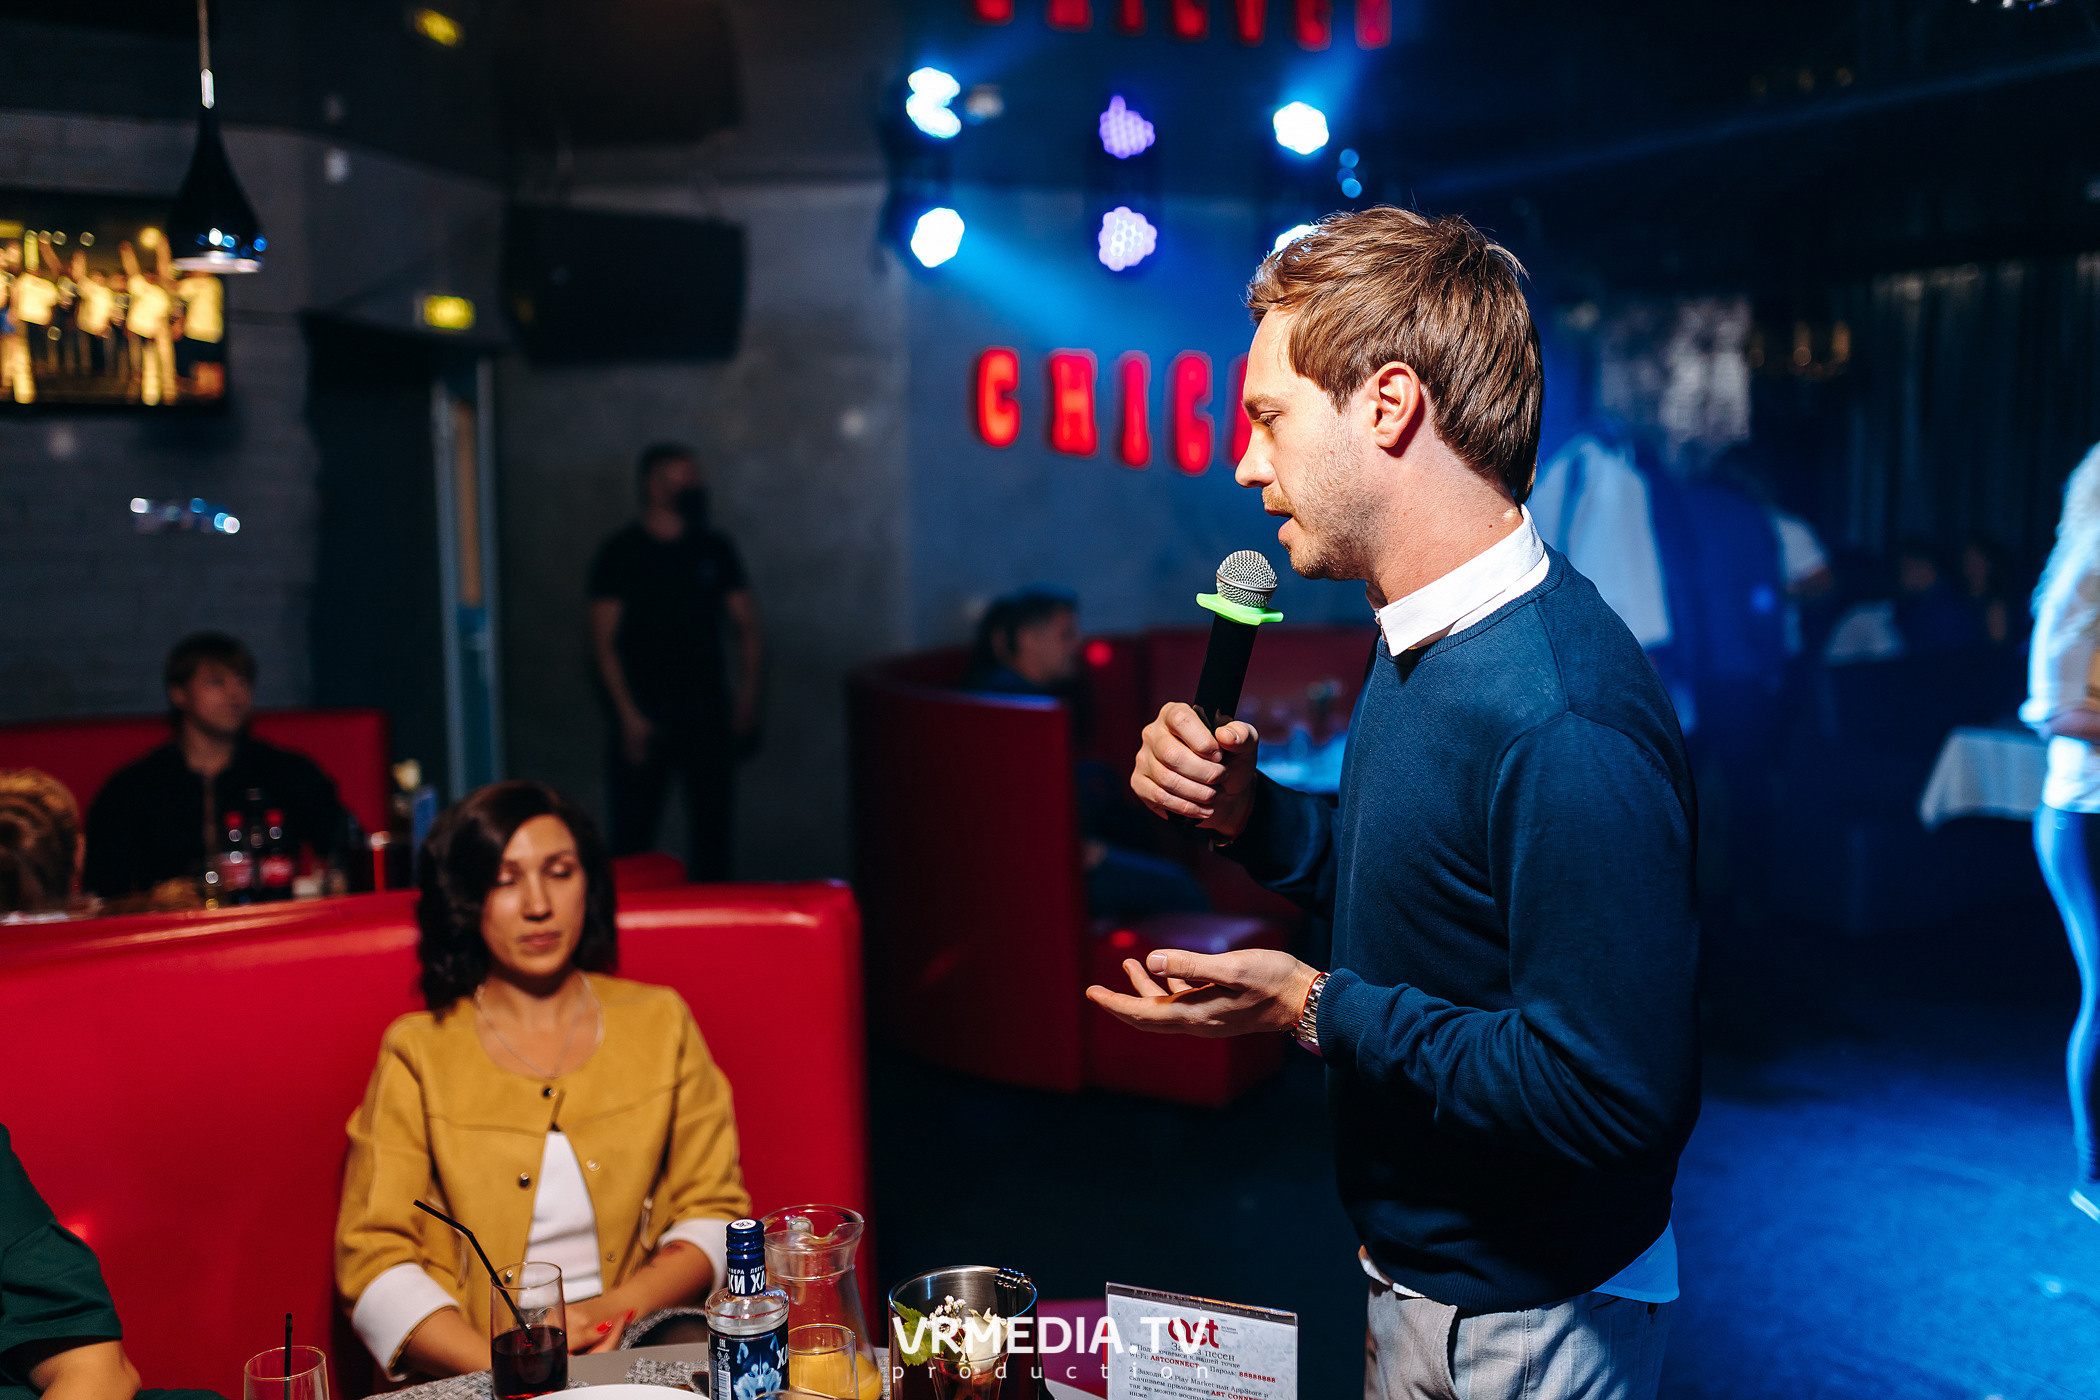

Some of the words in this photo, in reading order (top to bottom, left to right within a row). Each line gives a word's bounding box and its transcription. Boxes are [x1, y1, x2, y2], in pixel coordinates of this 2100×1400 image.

[976, 347, 1248, 475] CHIC
[1171, 1342, 1202, 1356] Заз
[1205, 1350, 1235, 1362] песен
[1138, 1367, 1166, 1378] Заходи
